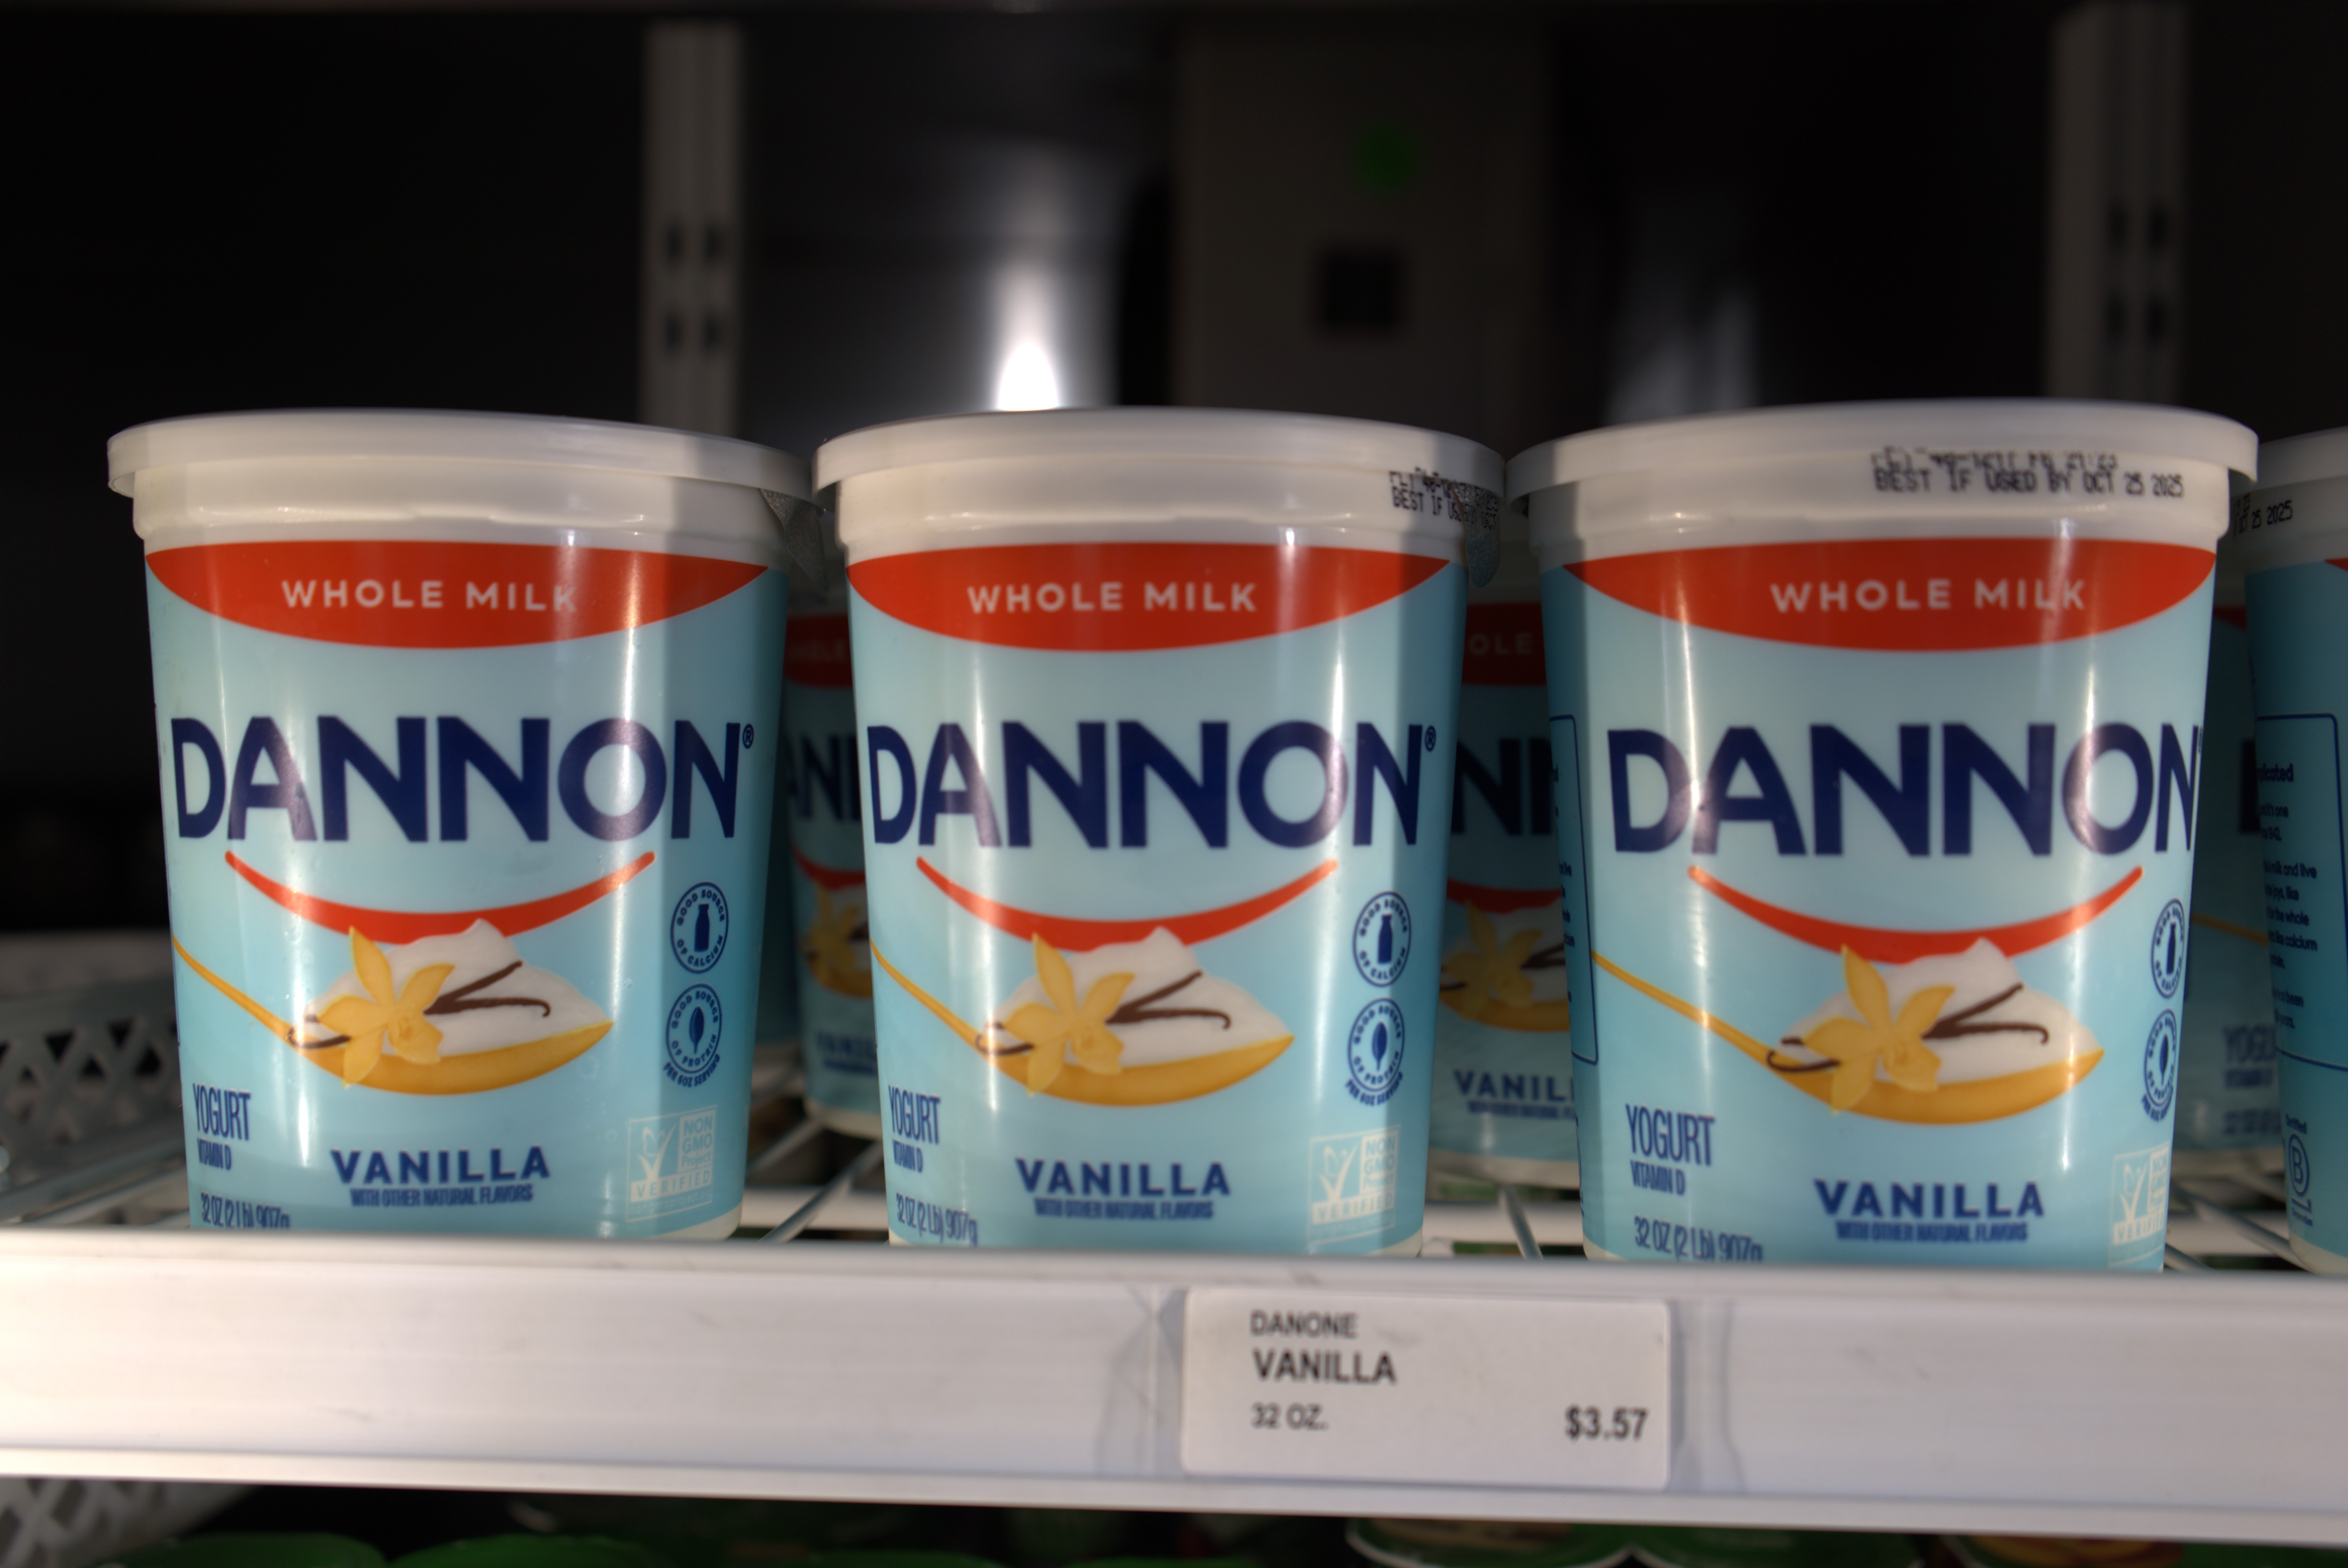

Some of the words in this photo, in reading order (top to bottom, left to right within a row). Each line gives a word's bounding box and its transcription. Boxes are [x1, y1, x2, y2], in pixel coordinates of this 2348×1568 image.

[1391, 486, 1424, 512] BEST
[1431, 495, 1443, 516] IF
[1874, 470, 1930, 493] BEST
[1949, 471, 1971, 493] IF
[2049, 471, 2072, 495] BY
[2151, 473, 2184, 498] 2025
[2266, 500, 2293, 526] 2025
[282, 579, 444, 609] WHOLE
[466, 582, 577, 613] MILK
[968, 583, 1123, 613] WHOLE
[1145, 583, 1257, 612] MILK
[1771, 579, 1952, 613] WHOLE
[1974, 579, 2086, 611] MILK
[1468, 631, 1533, 657] OLE
[677, 892, 698, 926] GOOD
[701, 889, 725, 922] SOURCE
[1360, 903, 1380, 937] GOOD
[2285, 909, 2309, 926] whole
[677, 938, 687, 955] OF
[688, 934, 723, 967] CALCIUM
[671, 995, 692, 1029] GOOD
[695, 991, 718, 1023] SOURCE
[1353, 1010, 1374, 1045] GOOD
[672, 1040, 682, 1056] OF
[682, 1033, 717, 1067] PROTEIN
[694, 1053, 720, 1087] SERVING
[1453, 1068, 1574, 1102] VANIL
[193, 1083, 251, 1141] YOGURT
[684, 1115, 713, 1137] NON
[888, 1084, 941, 1145] YOGURT
[682, 1132, 713, 1154] GMO
[1625, 1103, 1716, 1167] YOGURT
[197, 1137, 224, 1169] VITAMIN
[225, 1144, 232, 1171] D
[329, 1145, 550, 1185] VANILLA
[681, 1151, 711, 1168] Project
[892, 1139, 916, 1171] VITAMIN
[916, 1147, 923, 1173] D
[636, 1170, 710, 1198] VERIFIED
[1015, 1157, 1231, 1197] VANILLA
[1630, 1160, 1673, 1194] VITAMIN
[1676, 1168, 1685, 1196] D
[201, 1192, 211, 1224] 32
[211, 1194, 224, 1227] OZ
[350, 1188, 379, 1207] WITH
[382, 1187, 421, 1207] OTHER
[423, 1185, 477, 1206] NATURAL
[480, 1182, 533, 1204] FLAVORS
[1813, 1178, 2044, 1218] VANILLA
[896, 1192, 905, 1224] 32
[905, 1195, 917, 1229] OZ
[945, 1208, 978, 1247] 907g
[1634, 1215, 1650, 1249] 32
[1653, 1219, 1672, 1254] OZ
[1250, 1310, 1358, 1339] DANONE
[1252, 1348, 1397, 1384] VANILLA
[1252, 1403, 1281, 1429] 32
[1286, 1403, 1328, 1431] OZ.
[1565, 1406, 1648, 1442] $3.57
